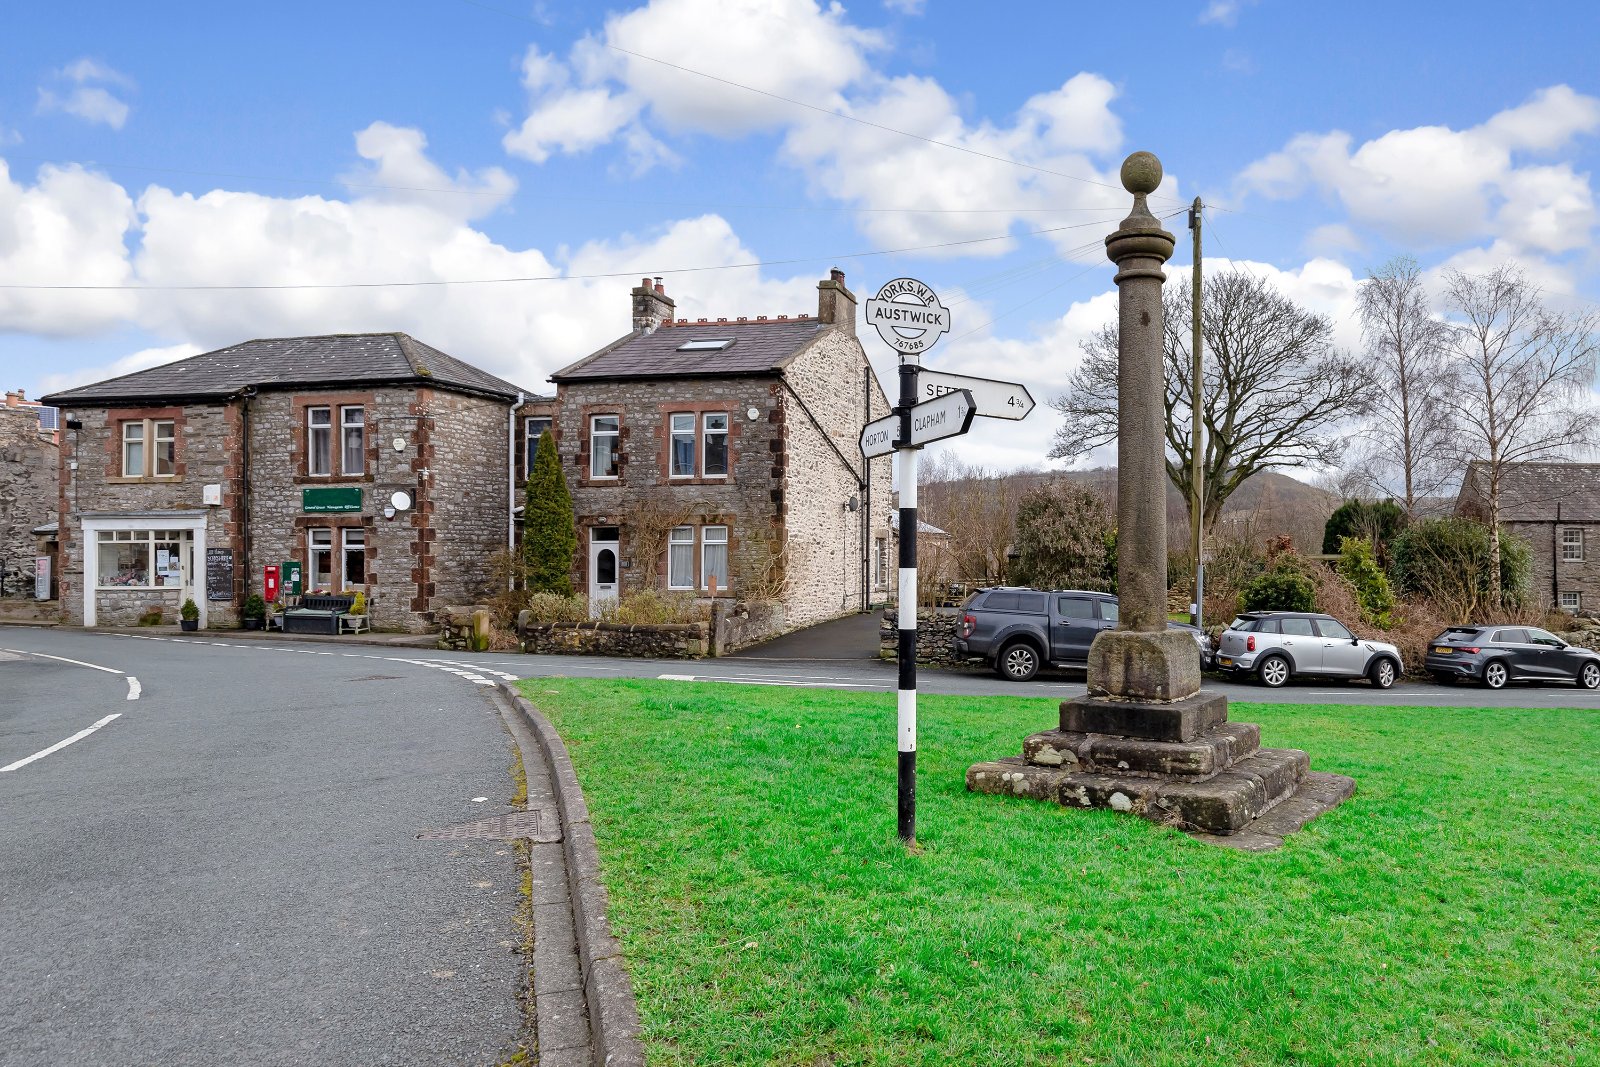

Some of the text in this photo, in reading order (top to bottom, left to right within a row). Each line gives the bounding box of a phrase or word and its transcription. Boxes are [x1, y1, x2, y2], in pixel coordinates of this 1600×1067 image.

[875, 307, 942, 325] AUSTWICK
[894, 338, 924, 350] 767685
[926, 384, 972, 397] SET
[914, 410, 946, 432] CLAPHAM
[865, 430, 889, 447] HORTON
